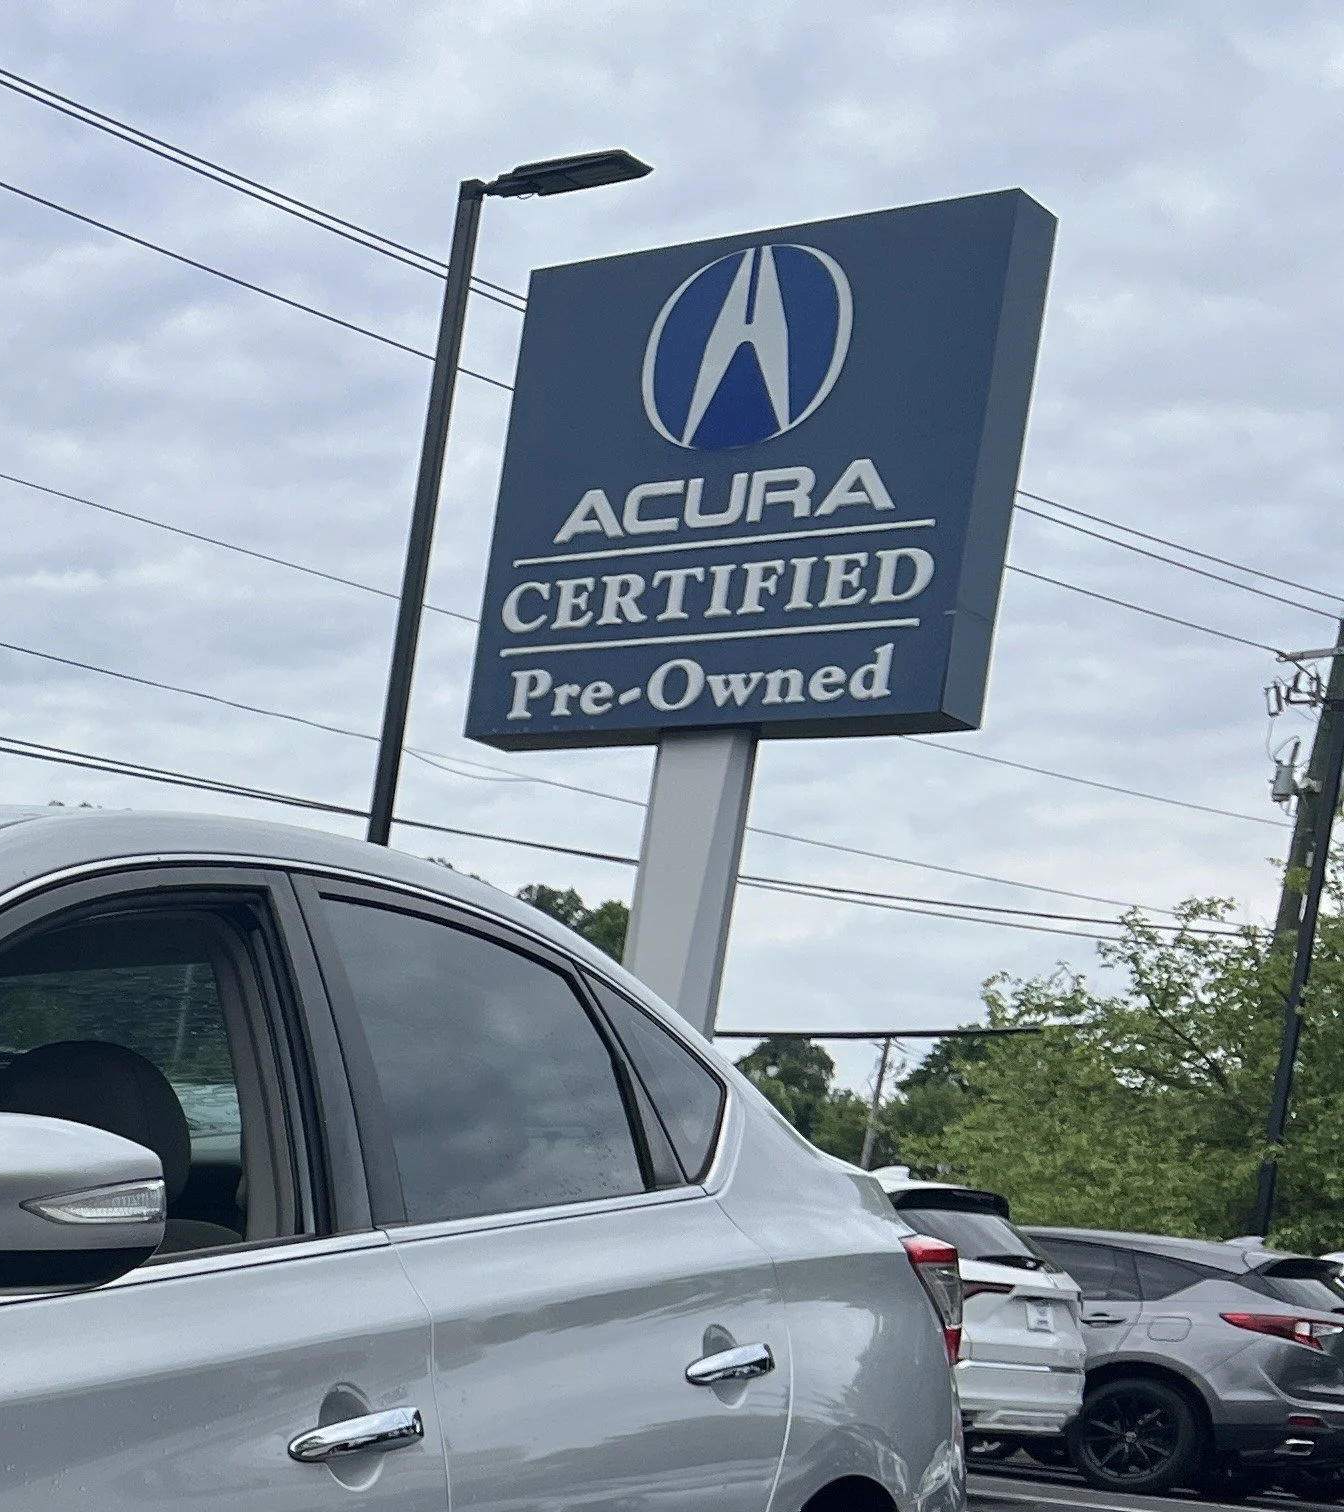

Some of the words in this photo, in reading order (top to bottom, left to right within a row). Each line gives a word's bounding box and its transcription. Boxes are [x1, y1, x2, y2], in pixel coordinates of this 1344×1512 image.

[552, 458, 897, 545] ACURA
[501, 547, 936, 634] CERTIFIED
[505, 642, 896, 721] Pre-Owned
